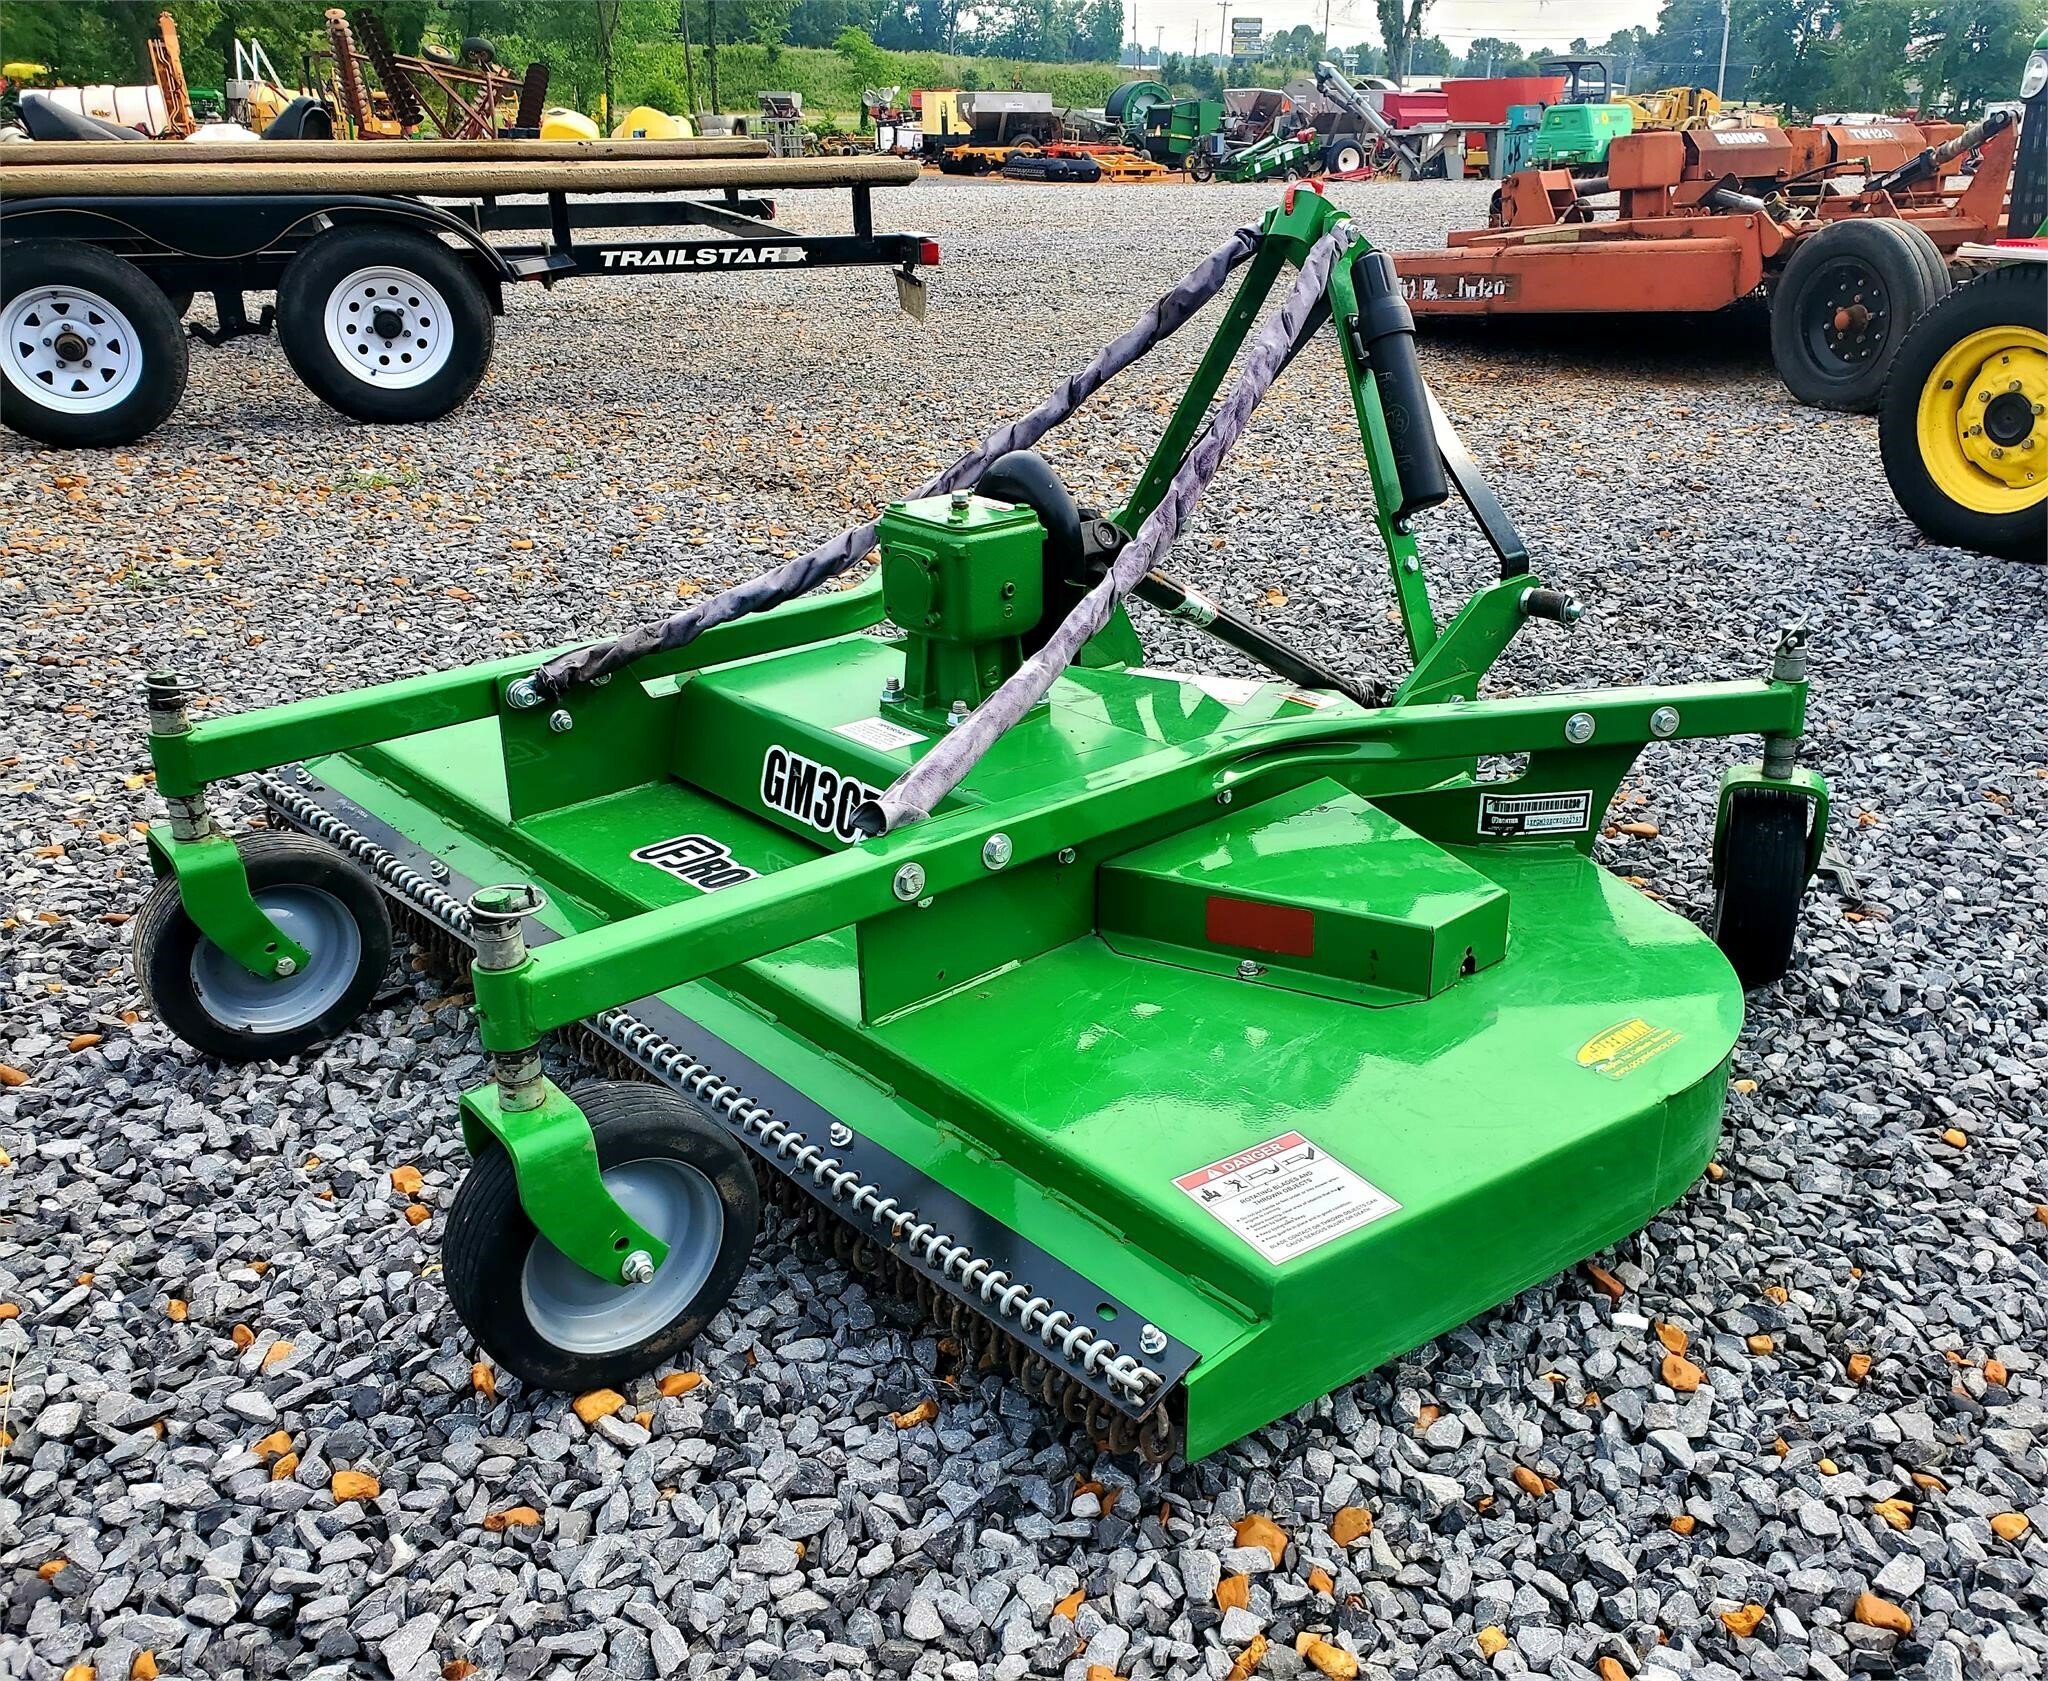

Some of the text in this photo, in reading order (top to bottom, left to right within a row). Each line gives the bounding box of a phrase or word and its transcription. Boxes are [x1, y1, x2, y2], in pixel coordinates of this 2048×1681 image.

[1714, 132, 1768, 145] RHINO
[600, 246, 781, 267] TRAILSTAR
[762, 749, 882, 840] GM30
[636, 836, 754, 889] FRO
[1222, 1142, 1283, 1171] DANGER
[1239, 1171, 1313, 1204] ROTATING BLADES AND
[1253, 1178, 1312, 1205] THROWN OBJECTS
